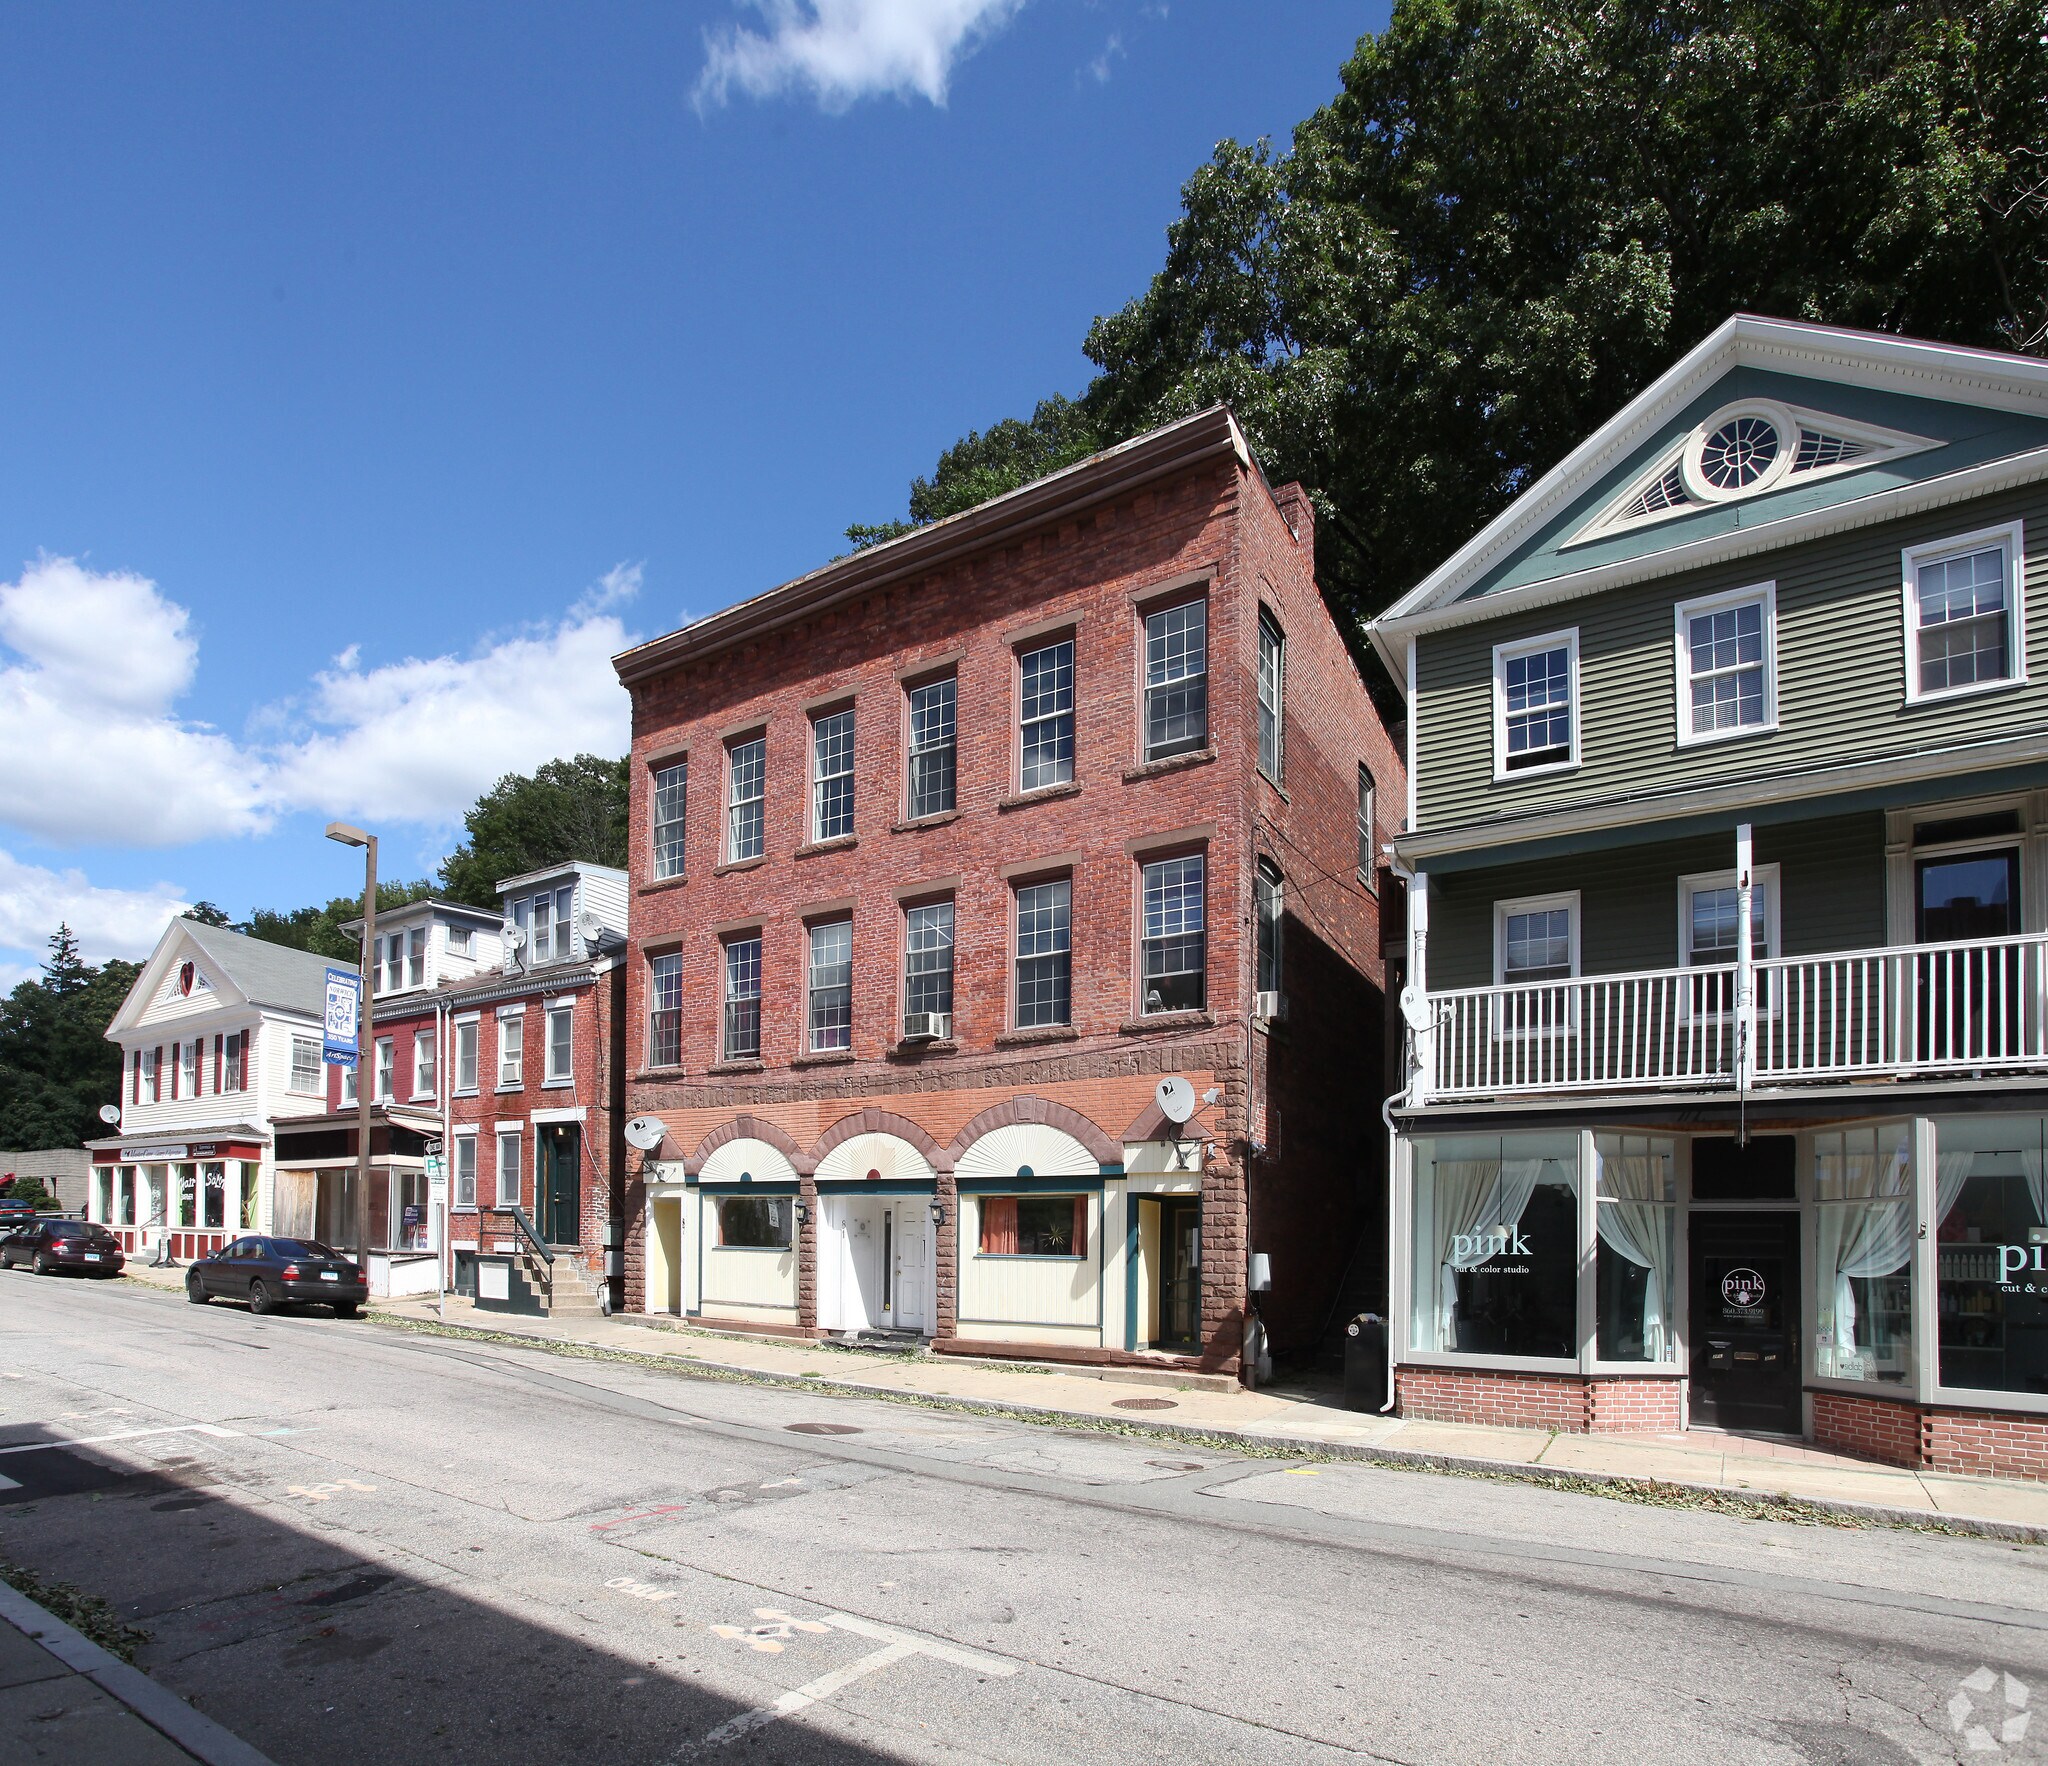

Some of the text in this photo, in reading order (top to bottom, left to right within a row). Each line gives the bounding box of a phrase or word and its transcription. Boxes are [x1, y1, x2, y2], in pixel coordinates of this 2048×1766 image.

[328, 972, 358, 988] CELEBRATING
[328, 985, 355, 998] NORWICH
[338, 1034, 354, 1045] YEARS
[326, 1050, 354, 1061] ArtSpace
[1398, 1117, 1415, 1131] 77
[1452, 1223, 1534, 1266] pink
[1995, 1233, 2047, 1284] pi
[1454, 1264, 1530, 1274] cut & color studio
[1723, 1275, 1764, 1295] pink
[2001, 1284, 2021, 1293] cut
[2024, 1282, 2037, 1294] &
[1722, 1307, 1764, 1315] 860.373.9199
